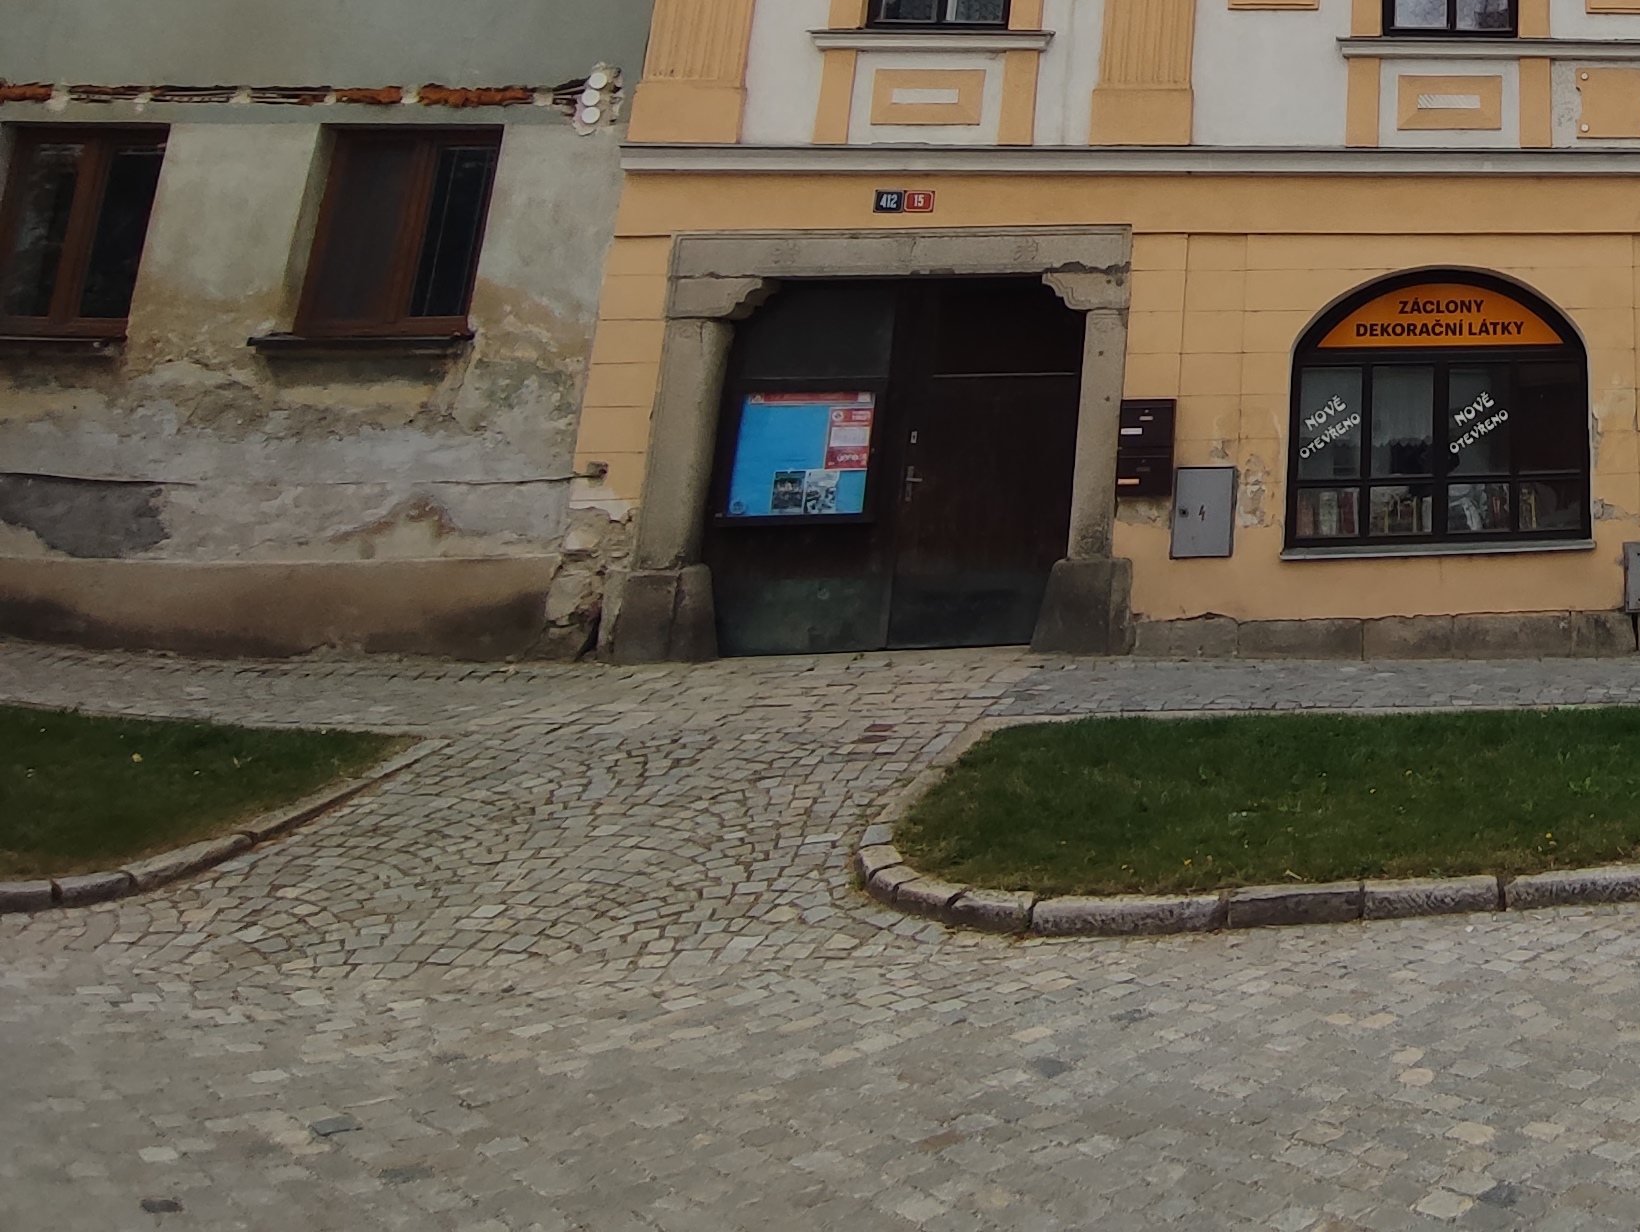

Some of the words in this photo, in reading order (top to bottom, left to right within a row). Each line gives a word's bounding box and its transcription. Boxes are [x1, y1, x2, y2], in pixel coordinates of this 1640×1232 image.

[880, 193, 898, 208] 412
[913, 194, 925, 207] 15
[1398, 297, 1485, 314] ZÁCLONY
[1355, 319, 1464, 337] DEKORAČNÍ
[1468, 319, 1525, 336] LÁTKY
[1304, 394, 1347, 431] NOVĚ
[1454, 391, 1495, 427] NOVĚ
[1300, 413, 1361, 459] OTEVŘENO
[1450, 409, 1509, 454] OTEVŘENO
